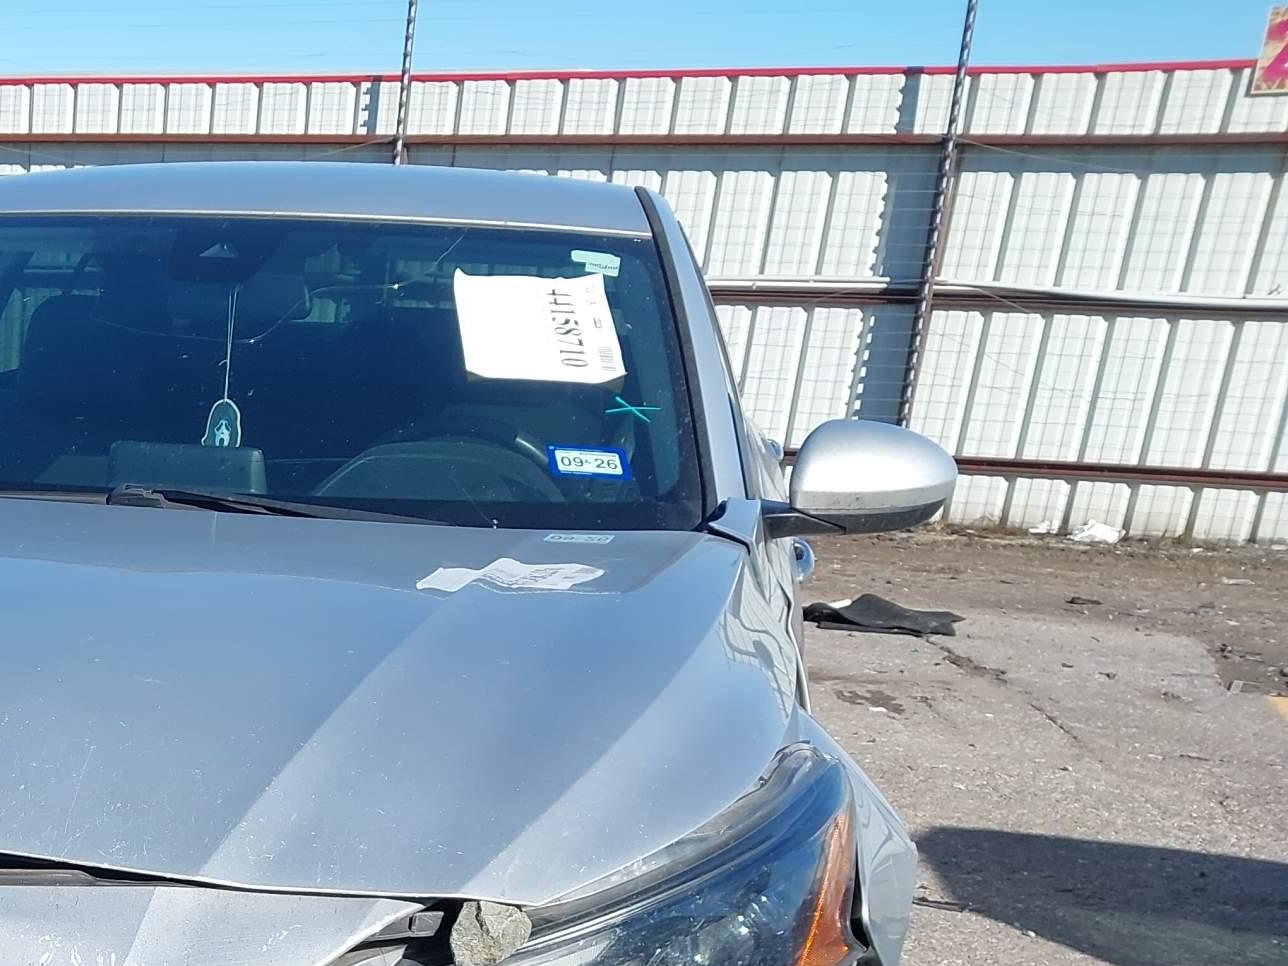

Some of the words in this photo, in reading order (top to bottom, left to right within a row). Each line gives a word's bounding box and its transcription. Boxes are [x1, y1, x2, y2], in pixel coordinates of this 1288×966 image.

[546, 288, 590, 368] 44158710
[560, 455, 584, 467] 09
[594, 457, 618, 470] 26
